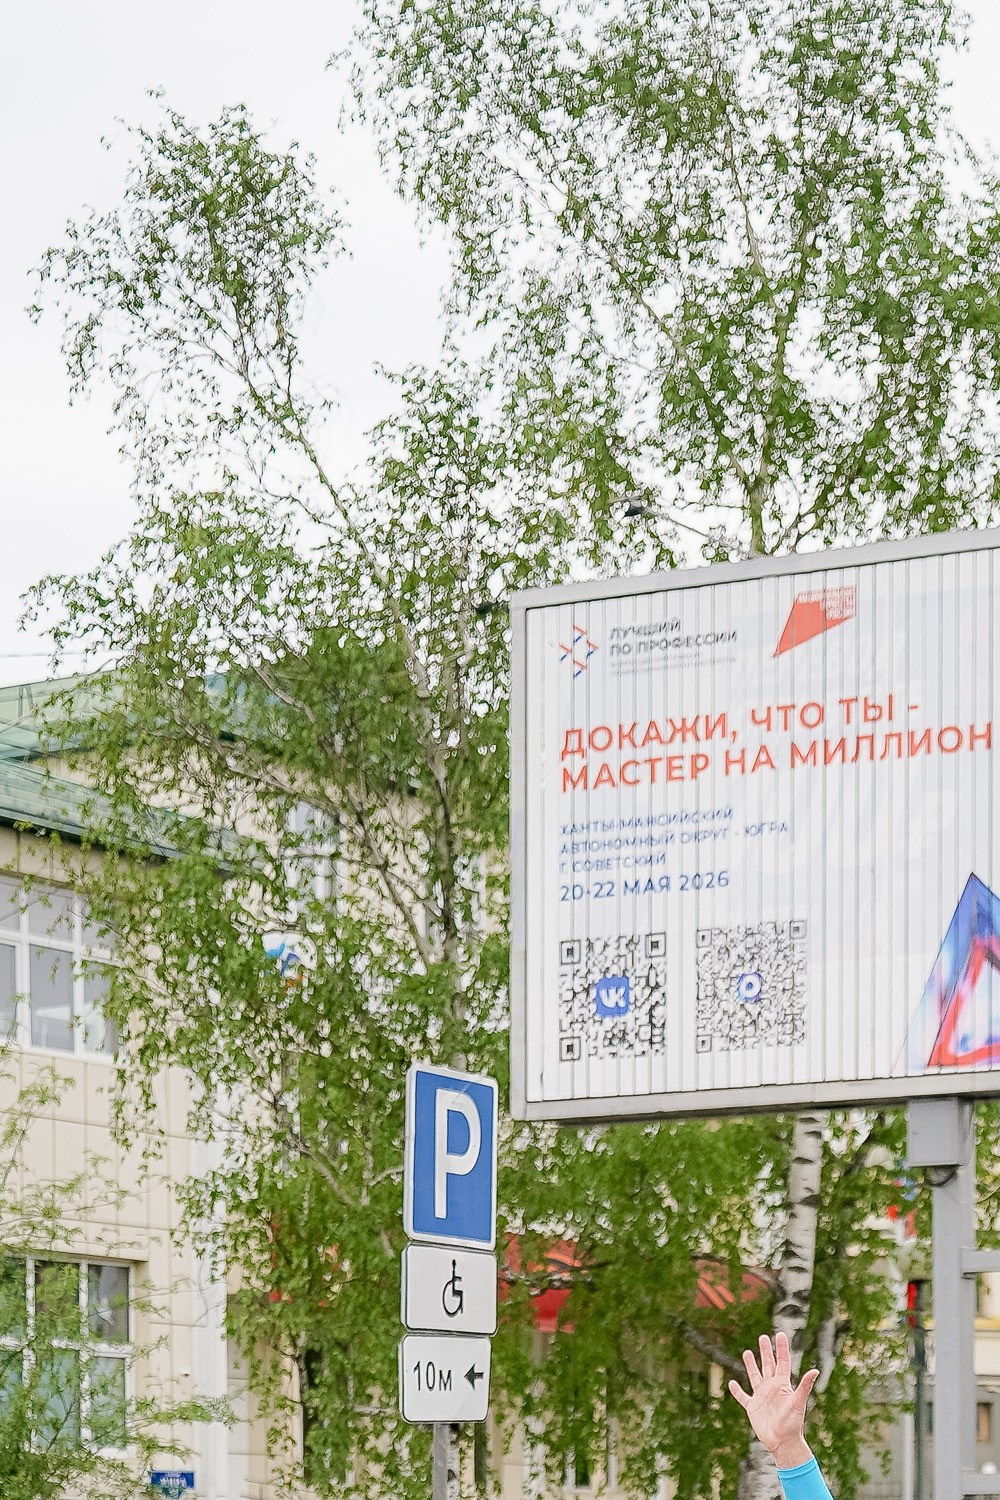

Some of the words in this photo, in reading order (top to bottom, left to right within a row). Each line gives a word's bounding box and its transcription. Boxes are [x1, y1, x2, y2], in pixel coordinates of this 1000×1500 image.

[610, 643, 632, 657] ПО
[638, 630, 737, 653] ПРОФЕССИИ
[561, 713, 738, 761] ДОКАЖИ,
[751, 702, 824, 732] ЧТО
[839, 694, 893, 725] ТЫ
[563, 754, 710, 793] МАСТЕР
[724, 746, 776, 777] НА
[790, 721, 992, 770] МИЛЛИОН
[623, 874, 671, 897] МАЯ
[679, 870, 730, 892] 2026
[434, 1086, 483, 1220] P
